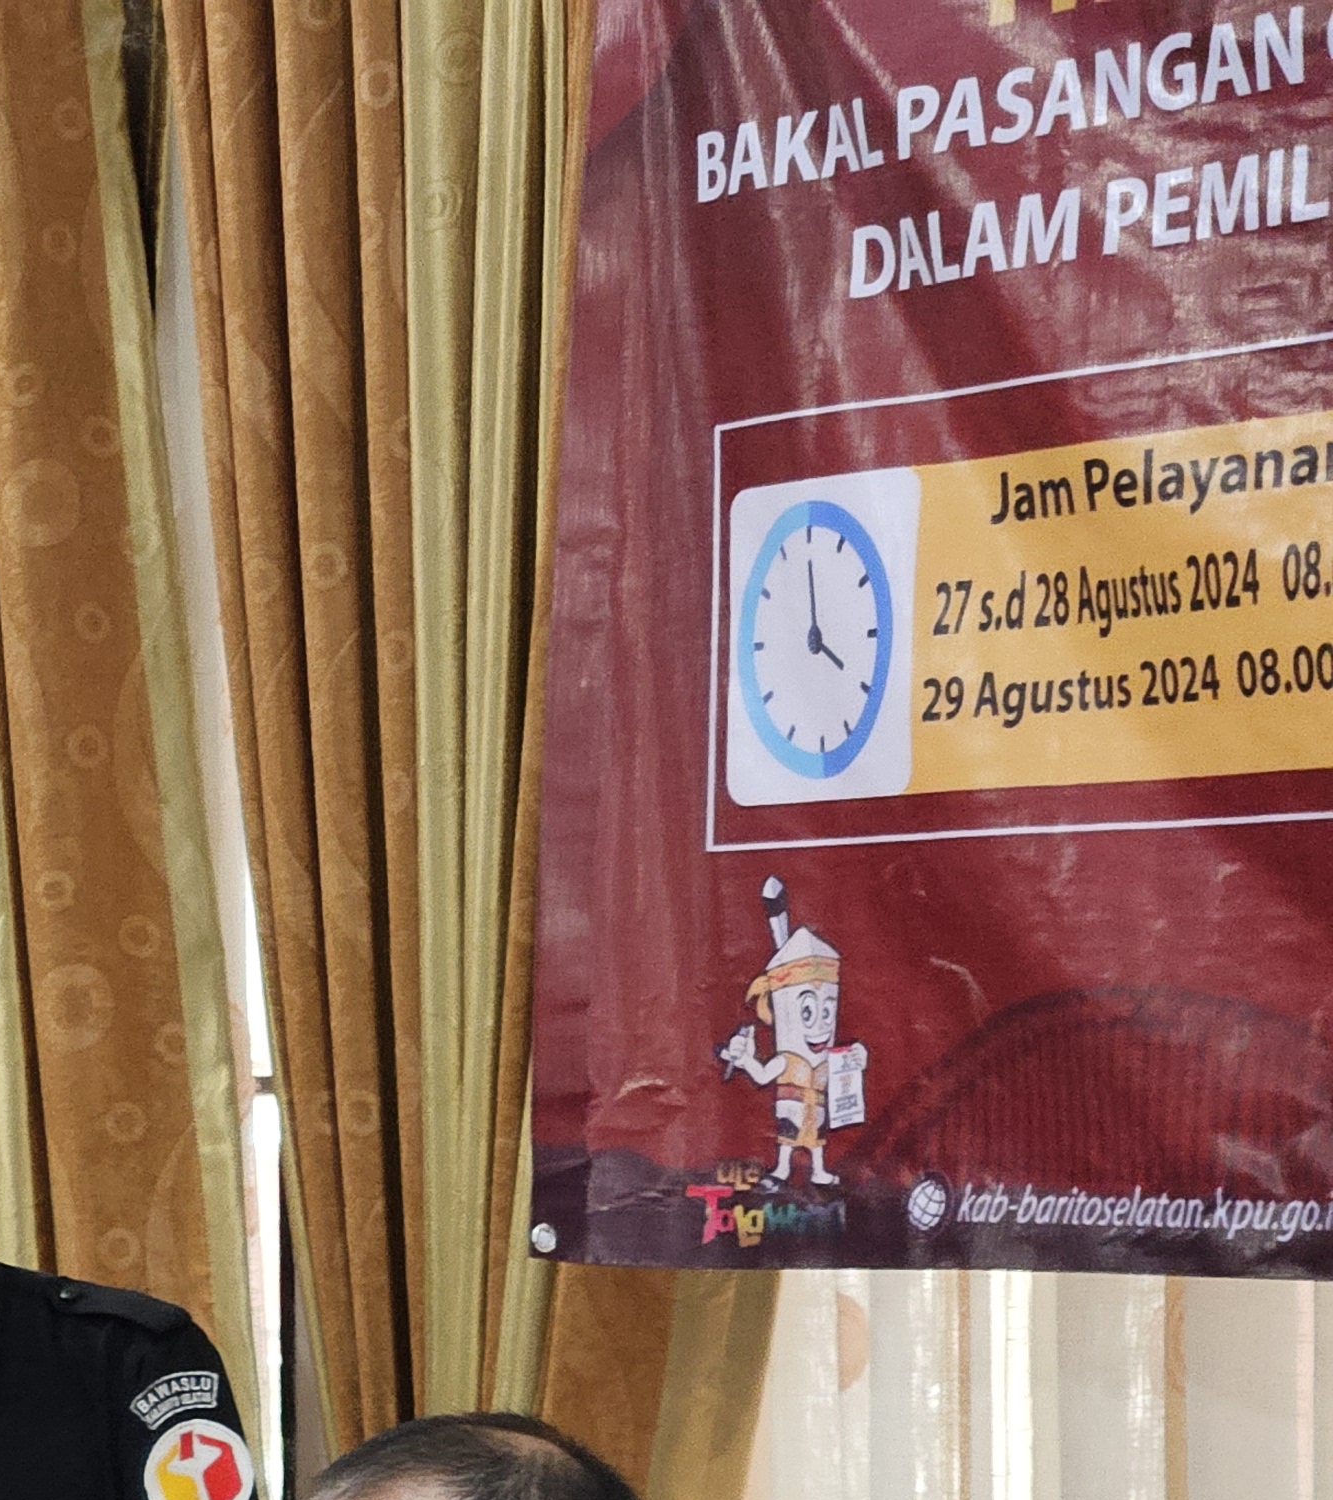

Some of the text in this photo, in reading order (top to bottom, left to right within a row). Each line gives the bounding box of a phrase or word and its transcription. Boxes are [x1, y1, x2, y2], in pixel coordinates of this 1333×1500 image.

[696, 97, 885, 204] BAKAL
[896, 5, 1305, 161] PASANGAN
[848, 144, 1330, 299] DALAM PEMIL
[989, 471, 1075, 525] Jam
[932, 579, 974, 637] 27
[978, 569, 1027, 633] s.d
[1033, 570, 1071, 628] 28
[1076, 565, 1183, 639] Agustus
[1185, 548, 1260, 613] 2024
[921, 641, 1333, 729] 29 Agustus 2024 08.00
[135, 1376, 212, 1414] BAWASLU
